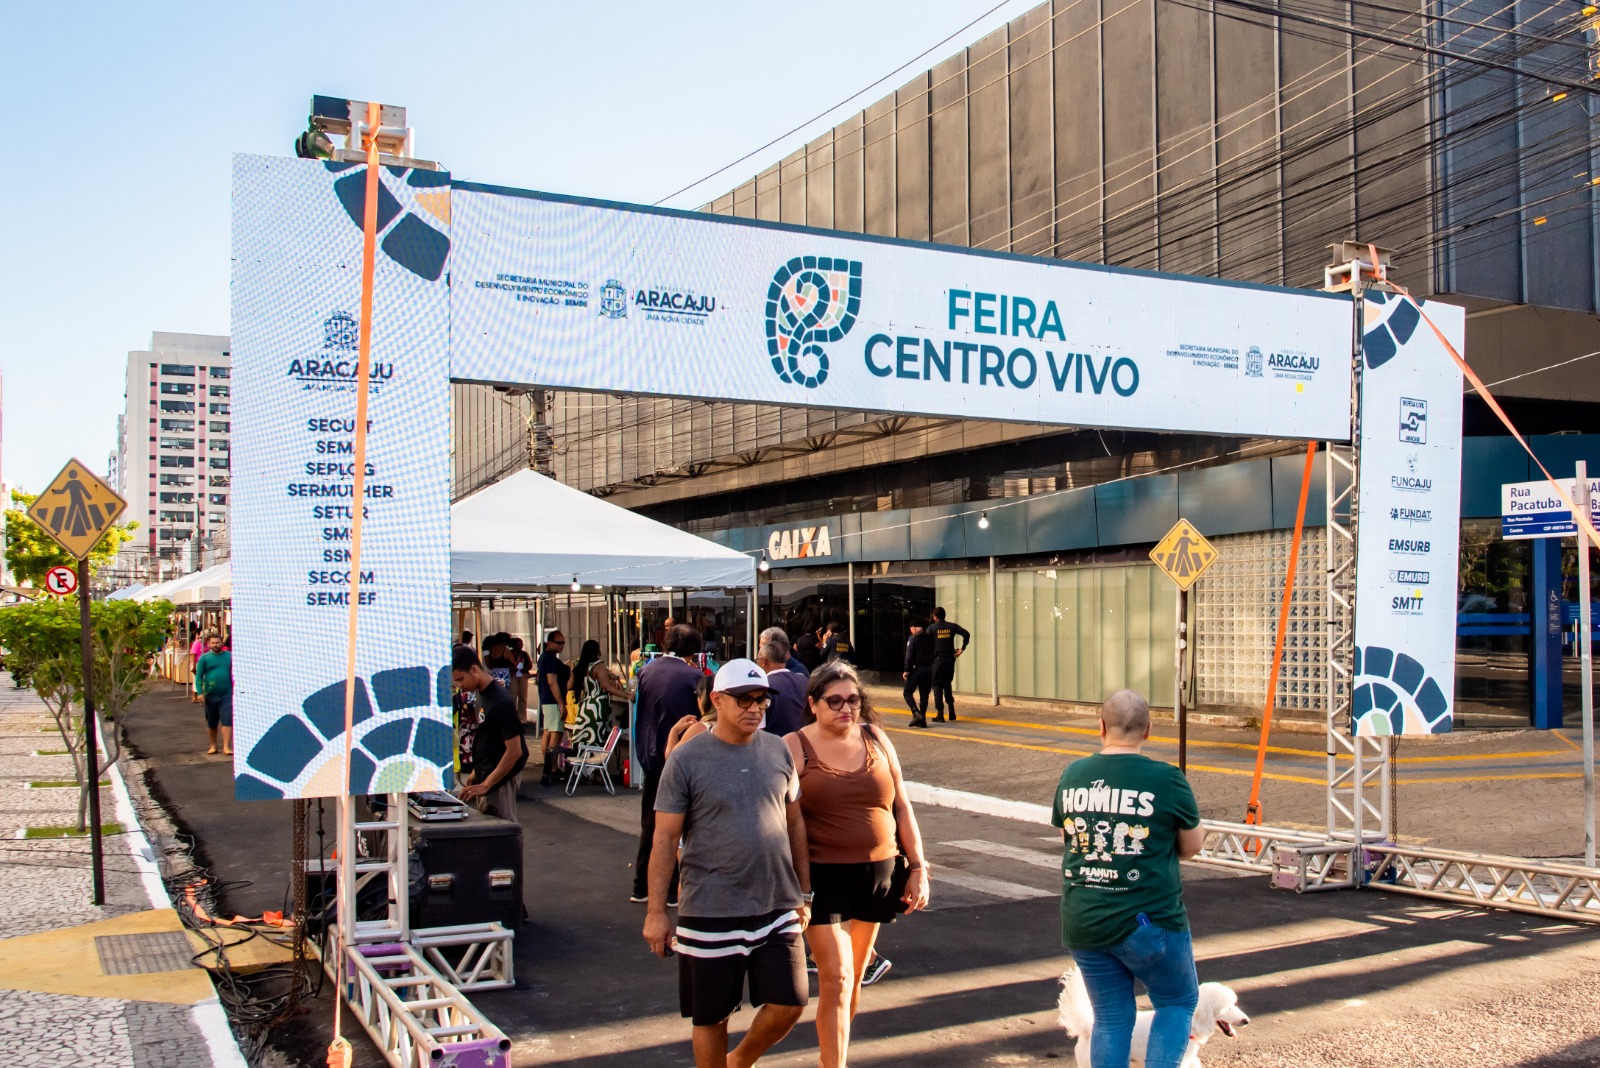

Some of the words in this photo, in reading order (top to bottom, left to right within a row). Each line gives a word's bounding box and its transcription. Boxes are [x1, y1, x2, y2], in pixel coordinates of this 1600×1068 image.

[496, 274, 537, 284] SECRETARIA
[538, 278, 576, 288] MUNICIPAL
[565, 299, 588, 307] SEMDE
[635, 290, 716, 312] ARACAJU
[948, 288, 1066, 341] FEIRA
[680, 317, 705, 326] CIDADE
[864, 333, 1038, 389] CENTRO
[1046, 350, 1140, 397] VIVO
[1268, 353, 1320, 370] ARACAJU
[308, 418, 373, 433] SECUT
[316, 440, 356, 454] SEM
[1392, 476, 1432, 489] FUNCAJU
[1511, 488, 1531, 497] Rua
[1511, 498, 1562, 511] Pacatuba
[323, 528, 352, 540] SM
[769, 526, 832, 560] CAIXA
[1389, 539, 1430, 552] EMSURB
[1399, 572, 1429, 582] EMURB
[1392, 596, 1423, 609] SMTT
[1062, 787, 1155, 817] HOMIES
[1080, 866, 1118, 879] PEANUTS
